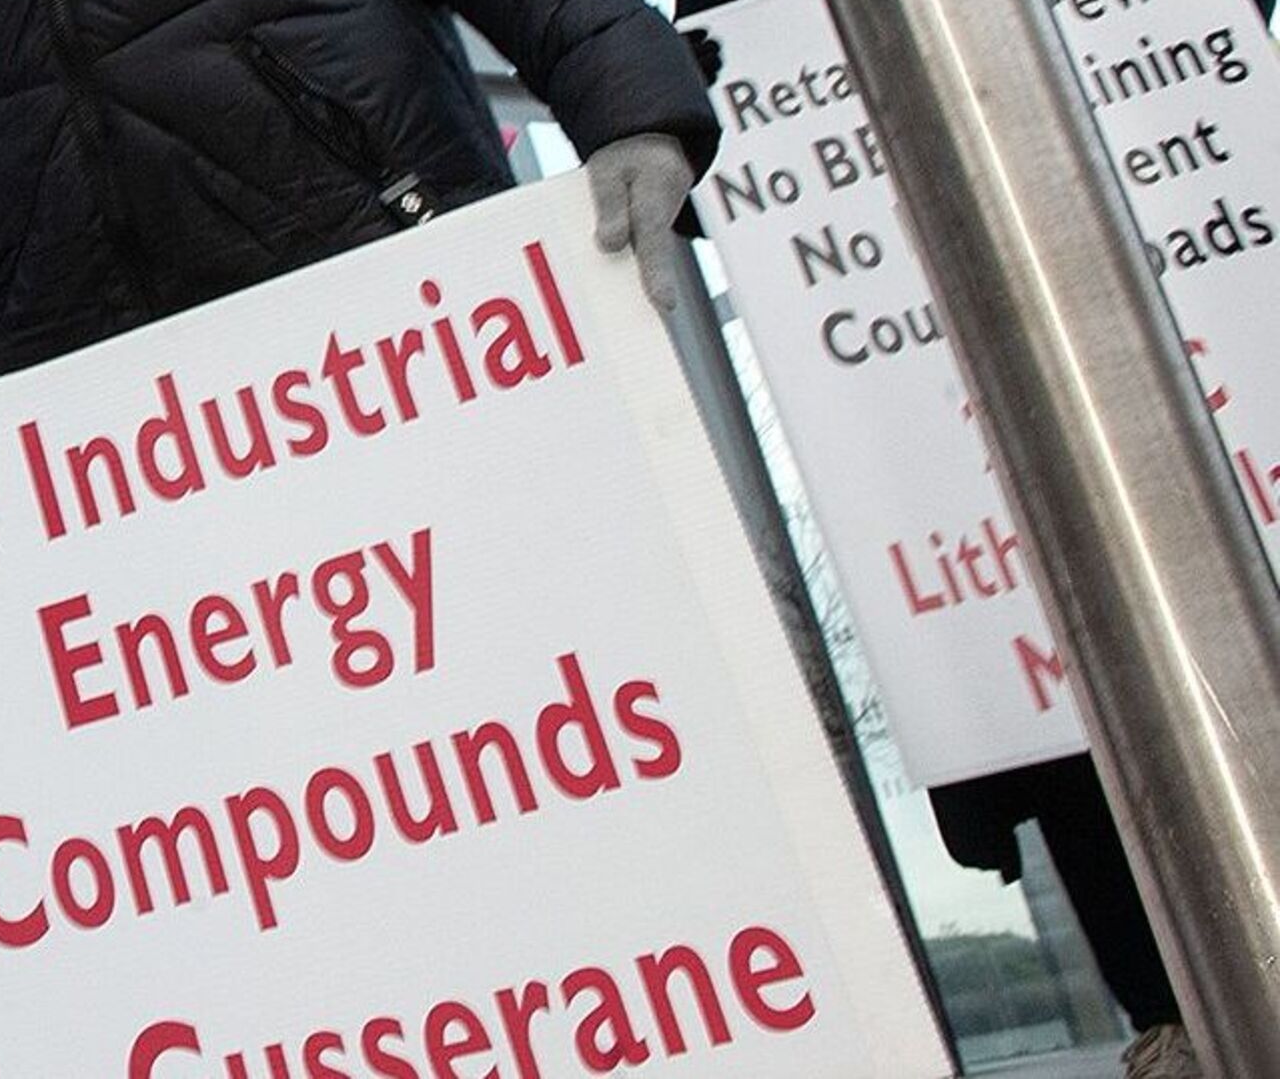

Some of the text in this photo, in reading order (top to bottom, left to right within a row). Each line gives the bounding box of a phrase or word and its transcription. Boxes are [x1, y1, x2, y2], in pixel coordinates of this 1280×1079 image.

[712, 163, 800, 222] No
[1090, 28, 1250, 107] ining
[791, 223, 882, 287] No
[19, 241, 585, 539] Industrial
[36, 529, 435, 730] Energy
[126, 925, 816, 1079] serane
